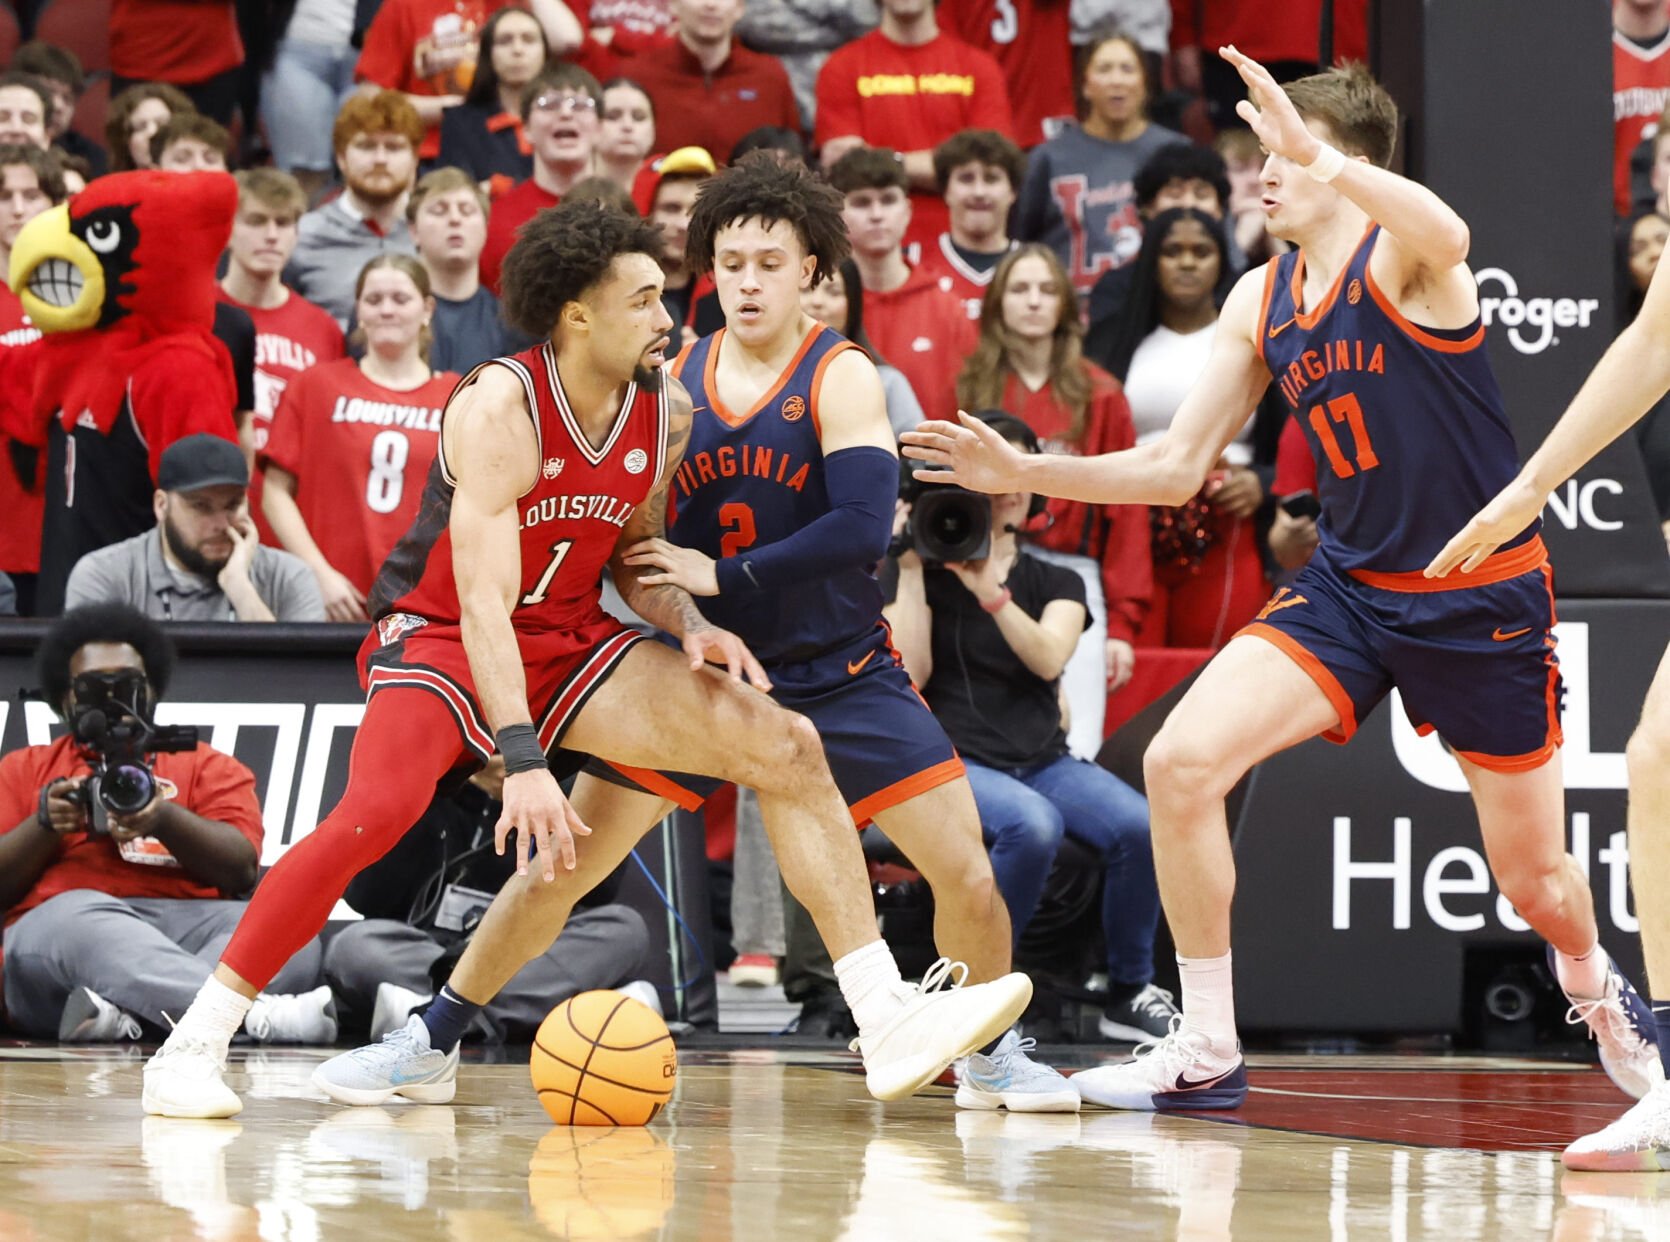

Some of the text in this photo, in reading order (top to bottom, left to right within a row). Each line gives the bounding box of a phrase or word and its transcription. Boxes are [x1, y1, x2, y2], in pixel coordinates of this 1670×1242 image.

[332, 396, 441, 432] LOUISVILL
[1309, 392, 1379, 478] 17
[366, 430, 409, 513] 8
[677, 444, 810, 496] VIRGINIA
[719, 503, 757, 558] 2
[1539, 478, 1623, 531] NC
[521, 540, 573, 604] 1
[1333, 812, 1641, 932] Helt
